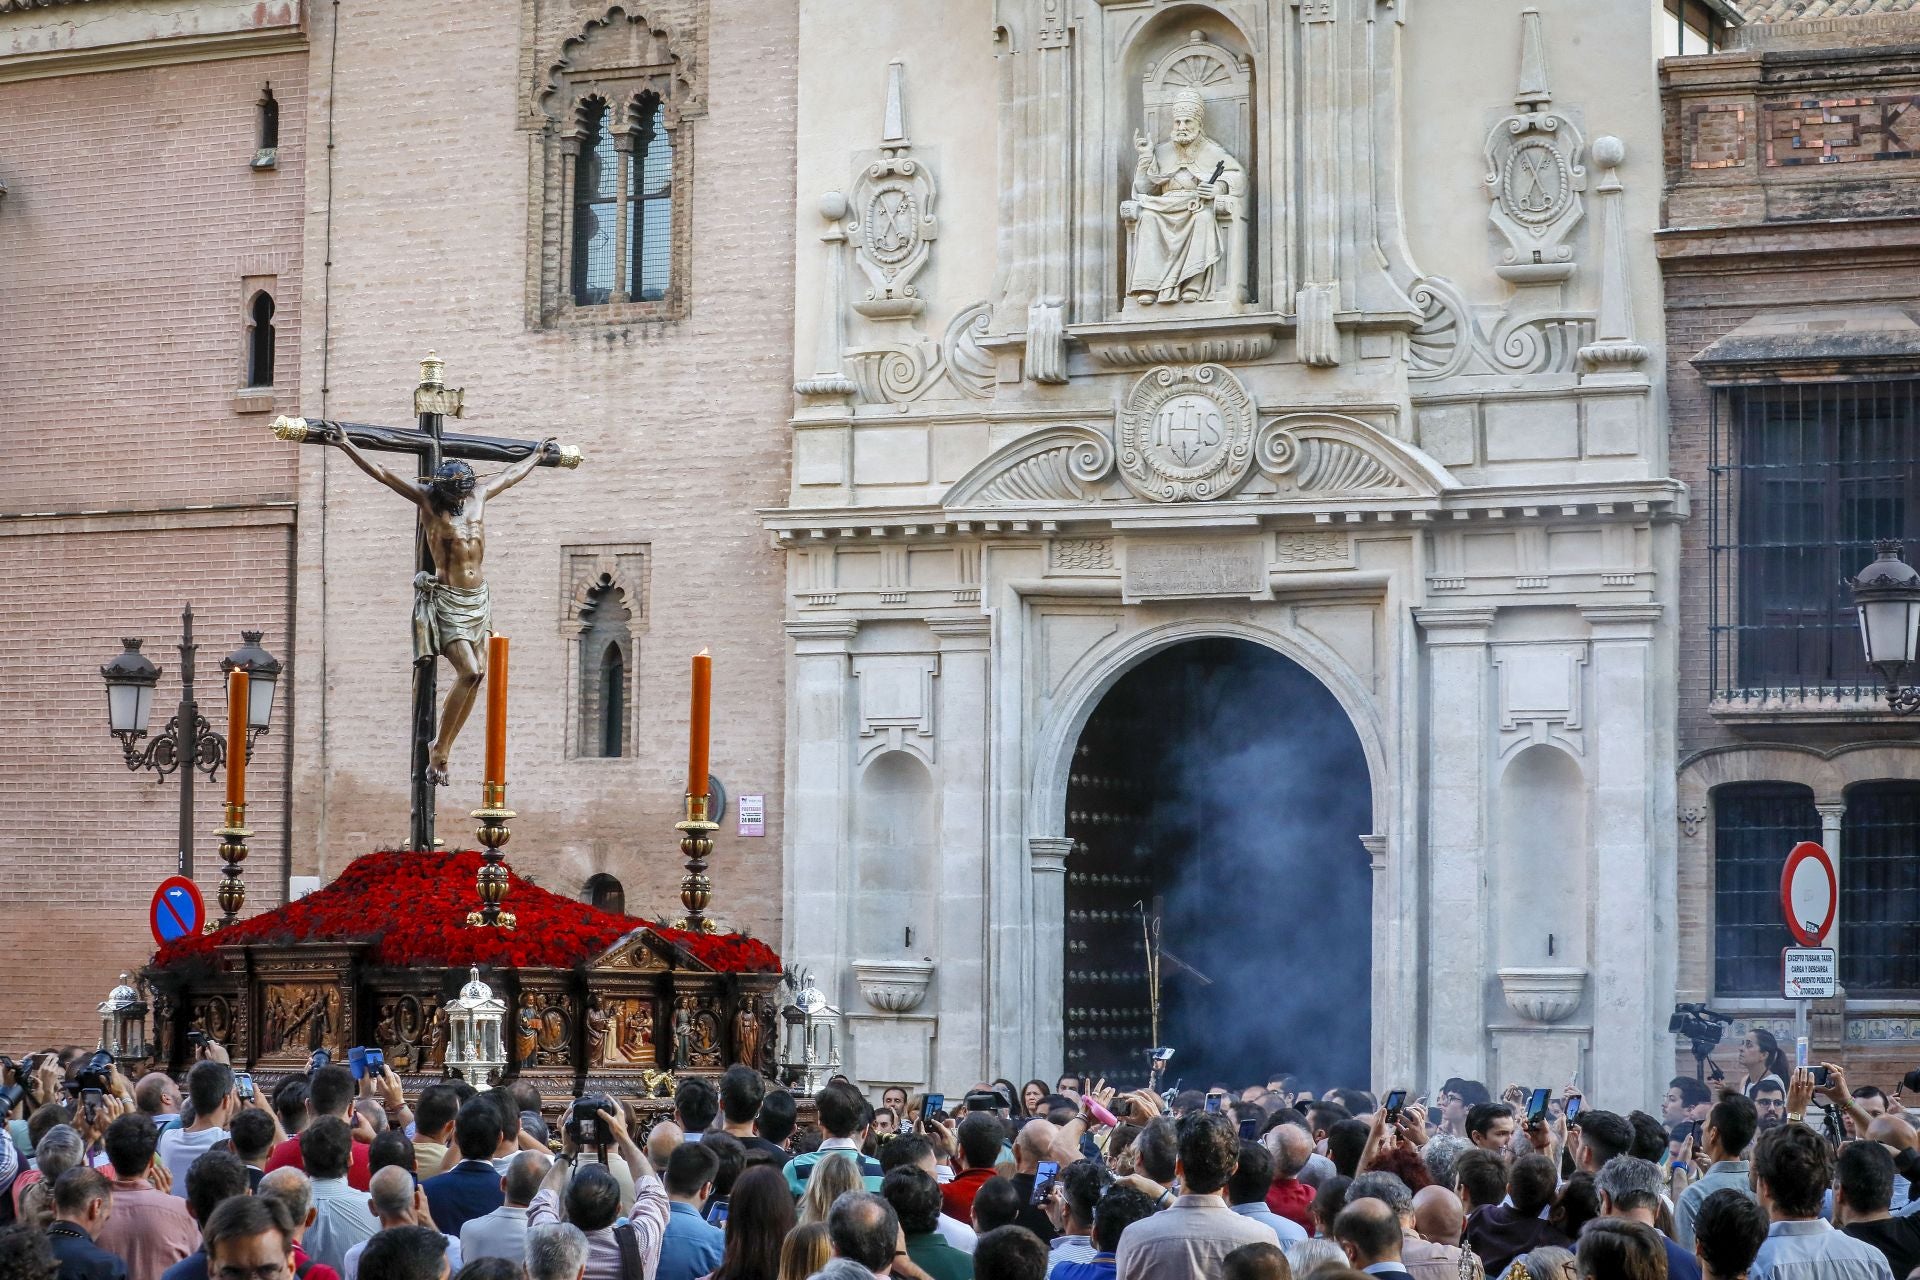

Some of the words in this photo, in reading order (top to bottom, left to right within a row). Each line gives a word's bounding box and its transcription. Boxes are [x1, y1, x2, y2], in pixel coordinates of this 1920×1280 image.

[1155, 411, 1221, 447] IHS
[1787, 954, 1805, 962] EXCEPTO
[1821, 954, 1832, 962] TAXIS
